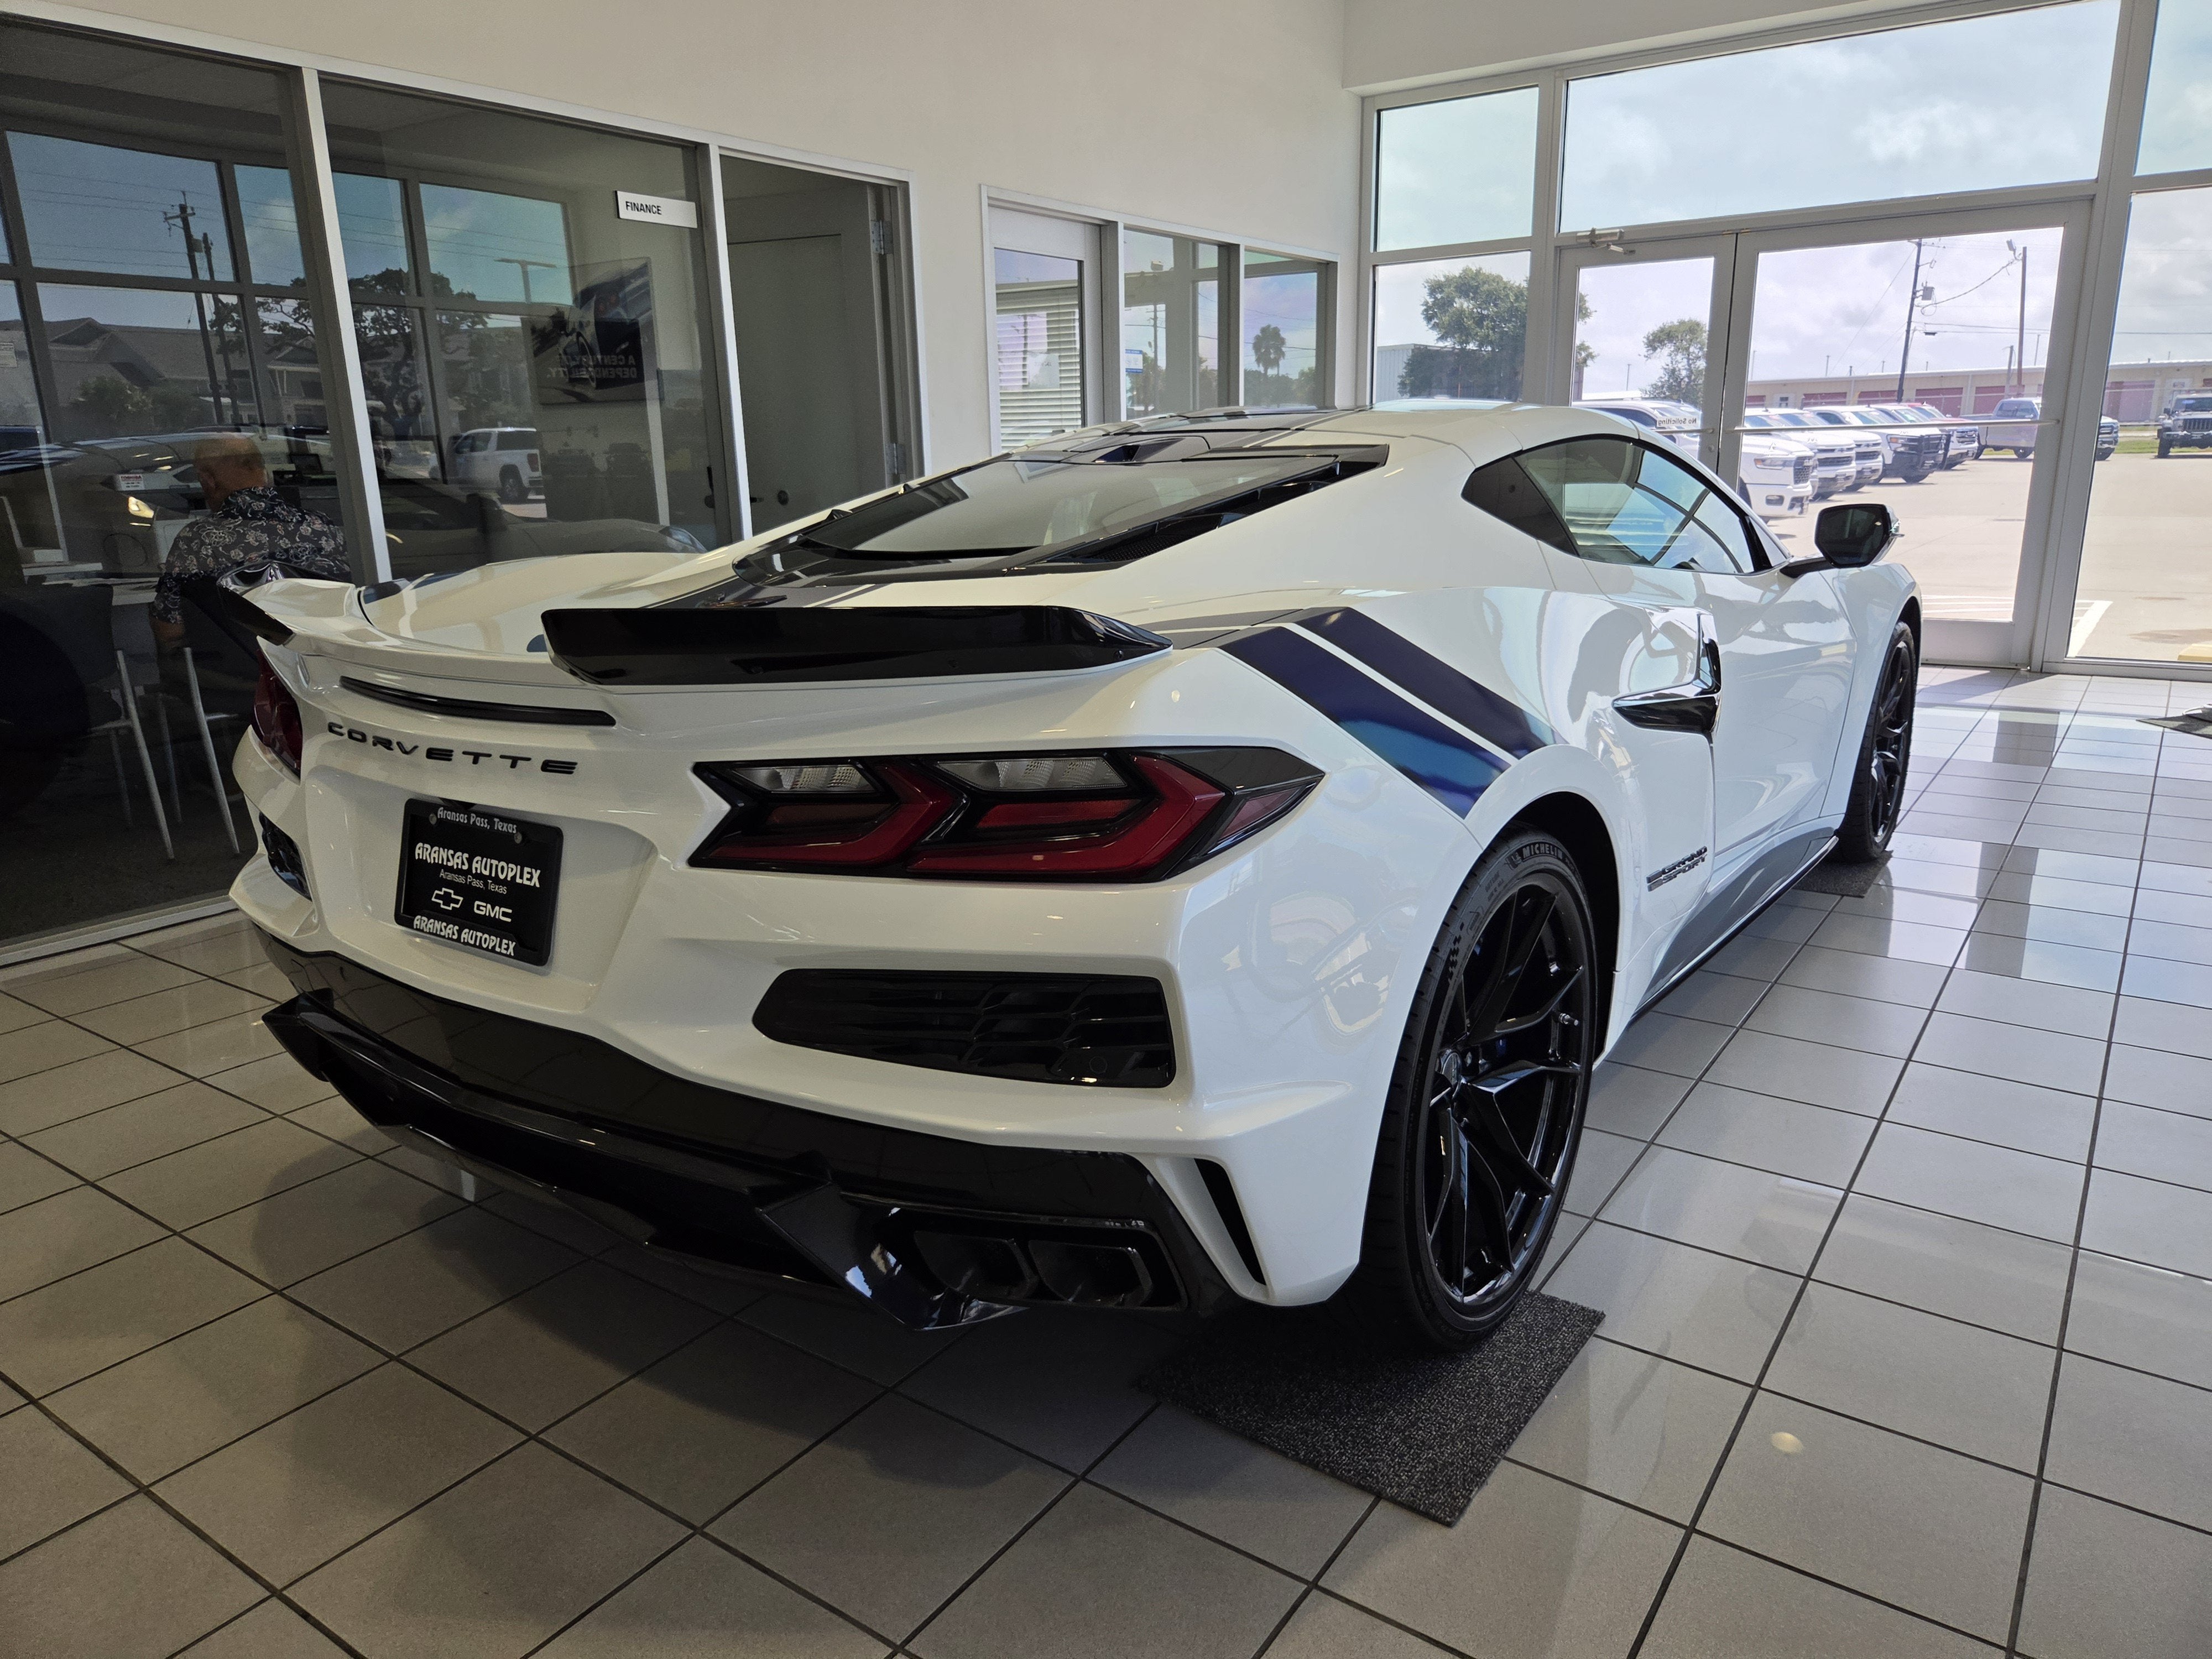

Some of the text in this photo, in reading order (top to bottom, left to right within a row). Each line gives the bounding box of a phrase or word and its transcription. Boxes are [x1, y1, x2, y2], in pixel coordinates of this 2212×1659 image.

[625, 201, 662, 215] FINANCE
[327, 721, 578, 774] CORVETTE
[437, 807, 518, 834] Aransas Pass, Texas
[1522, 842, 1563, 859] MICHELIN
[415, 842, 541, 888] ARANSAS AUTOPLEX
[440, 869, 507, 894] Aransas Pass, Texas
[473, 900, 513, 922] GMC
[414, 915, 516, 956] ARANSAS AUTOPLEX
